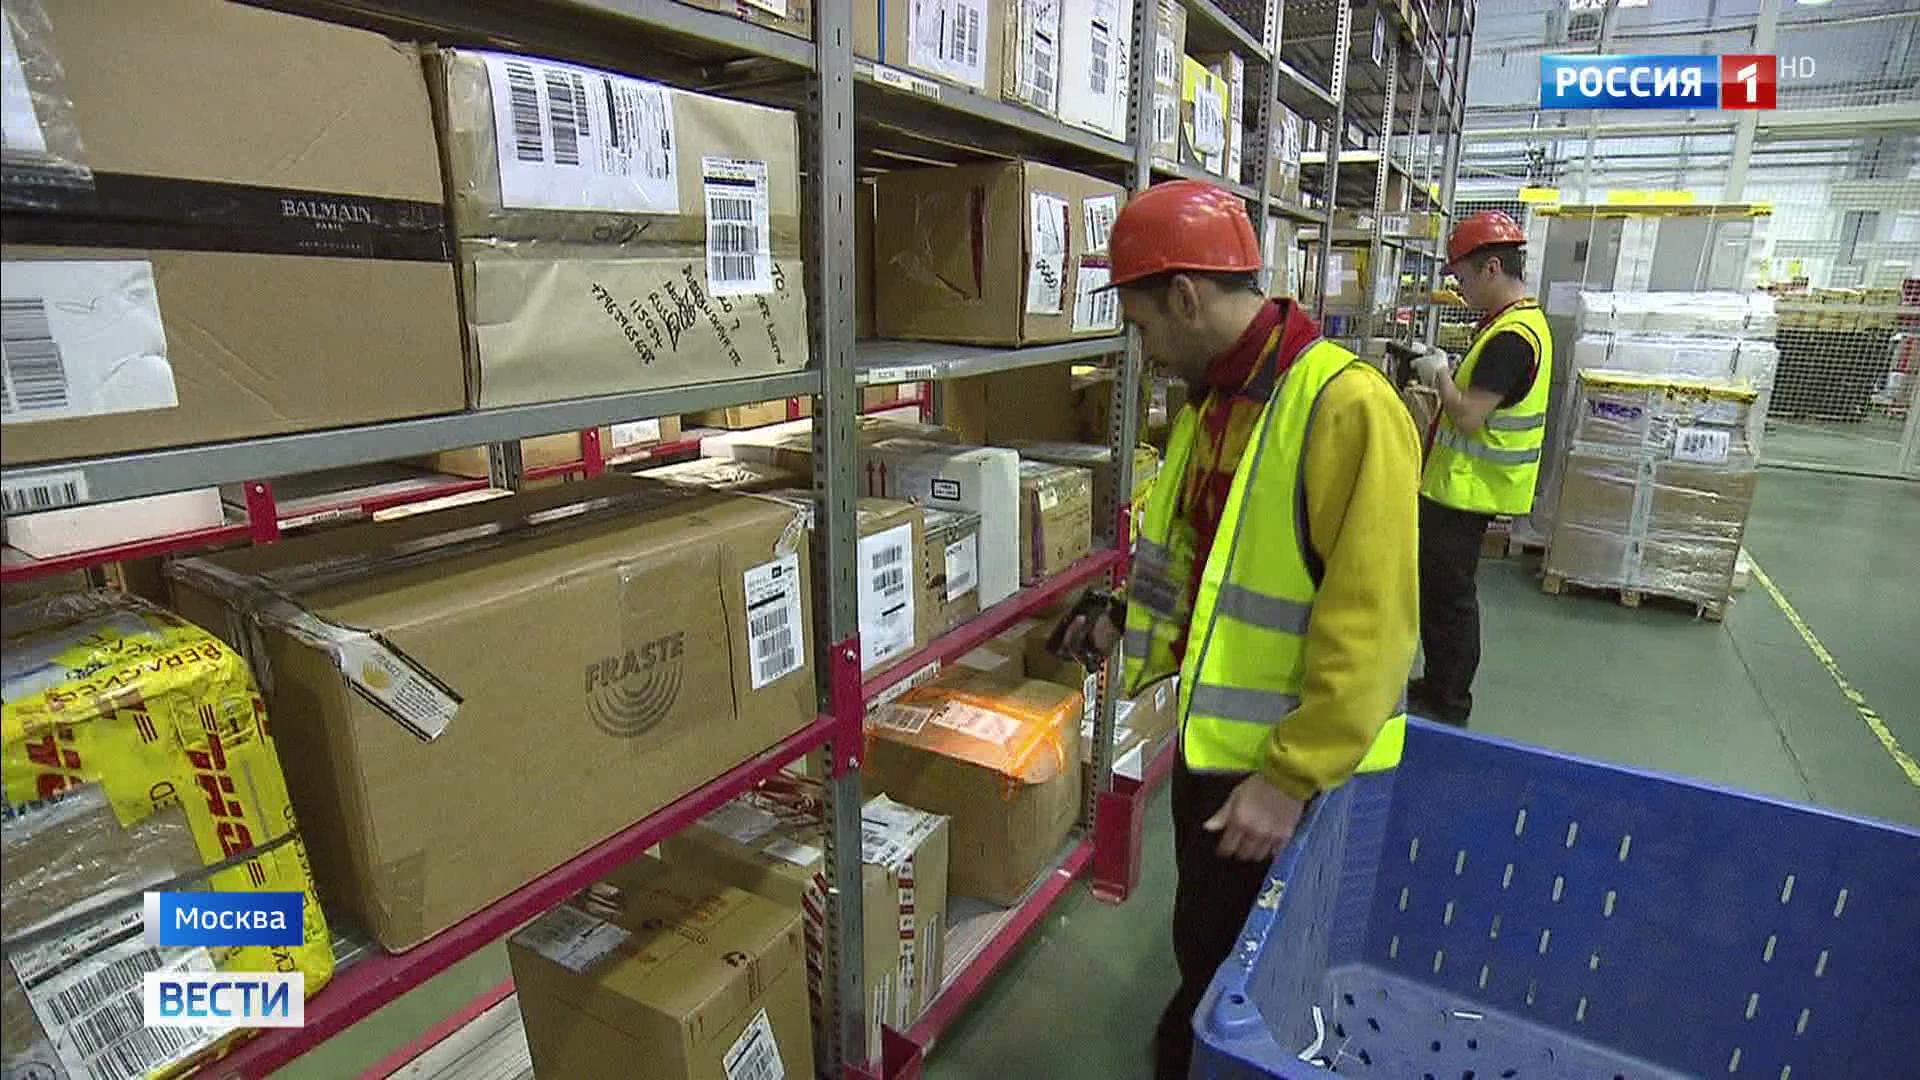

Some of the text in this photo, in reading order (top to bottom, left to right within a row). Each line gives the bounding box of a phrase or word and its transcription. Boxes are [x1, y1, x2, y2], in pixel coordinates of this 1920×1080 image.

[281, 199, 372, 224] BALMAIN
[585, 631, 684, 693] FRASTE
[187, 733, 257, 857] DHL
